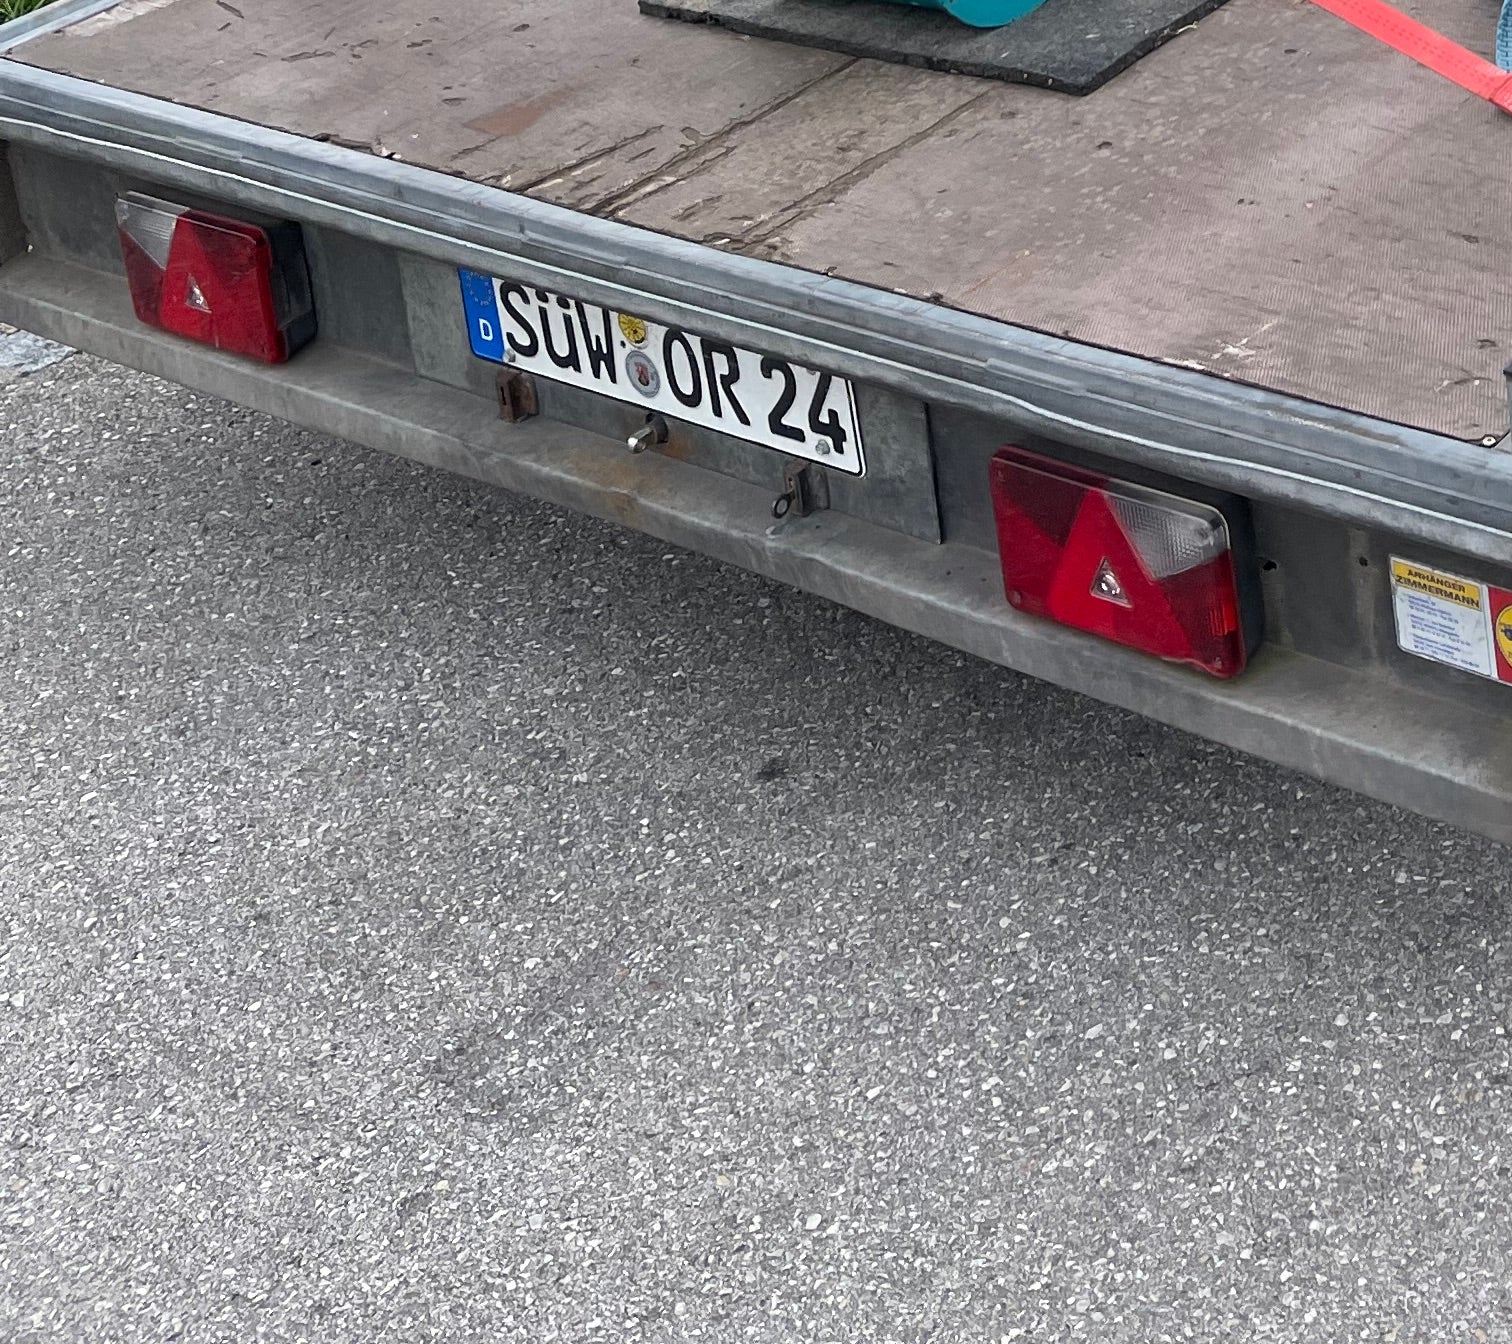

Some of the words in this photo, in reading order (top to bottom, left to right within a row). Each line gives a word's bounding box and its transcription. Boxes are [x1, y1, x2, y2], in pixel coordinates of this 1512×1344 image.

[478, 317, 495, 342] D
[499, 280, 617, 385] SÜW
[661, 325, 752, 427] OR
[760, 355, 848, 455] 24
[1395, 574, 1480, 609] ZIMMERMANN
[1407, 569, 1466, 594] ANHÄNGER
